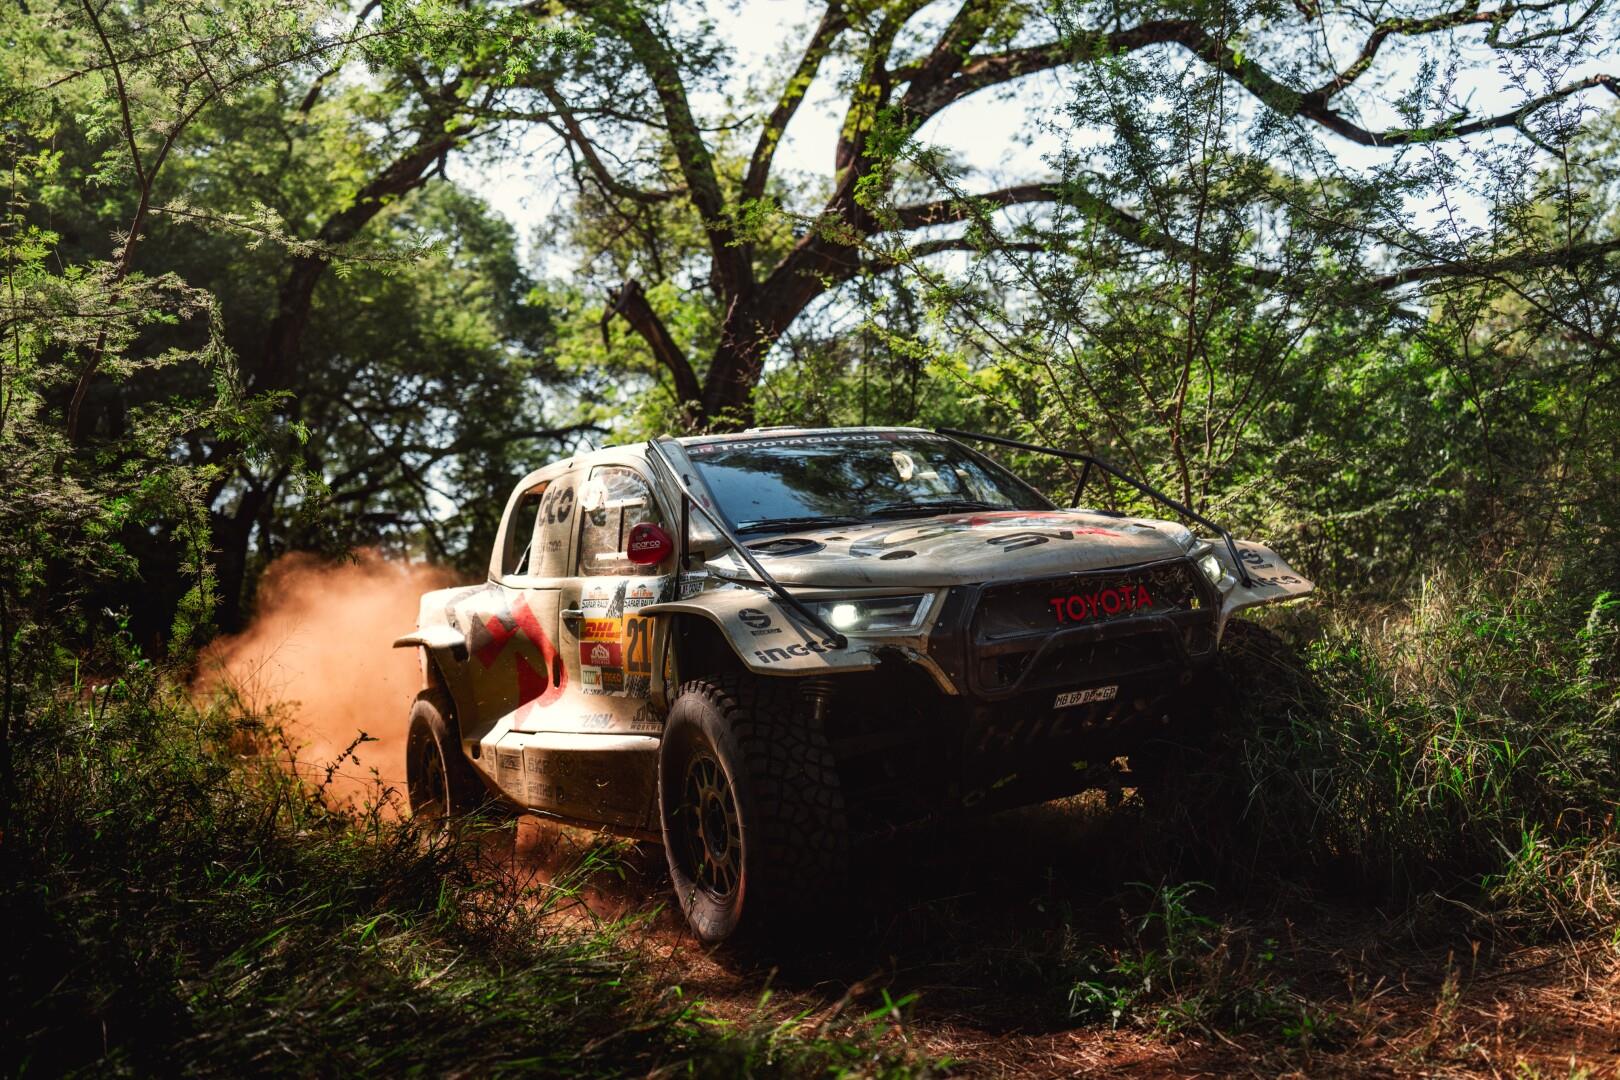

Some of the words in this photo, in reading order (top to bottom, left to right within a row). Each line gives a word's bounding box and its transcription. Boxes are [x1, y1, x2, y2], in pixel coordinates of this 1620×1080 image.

[716, 440, 801, 450] TOYOTA
[806, 434, 880, 444] GAZOO
[884, 432, 949, 442] acing
[631, 540, 661, 550] sparco
[1050, 585, 1153, 623] TOYOTA
[584, 622, 615, 638] DHL
[626, 618, 653, 672] 21
